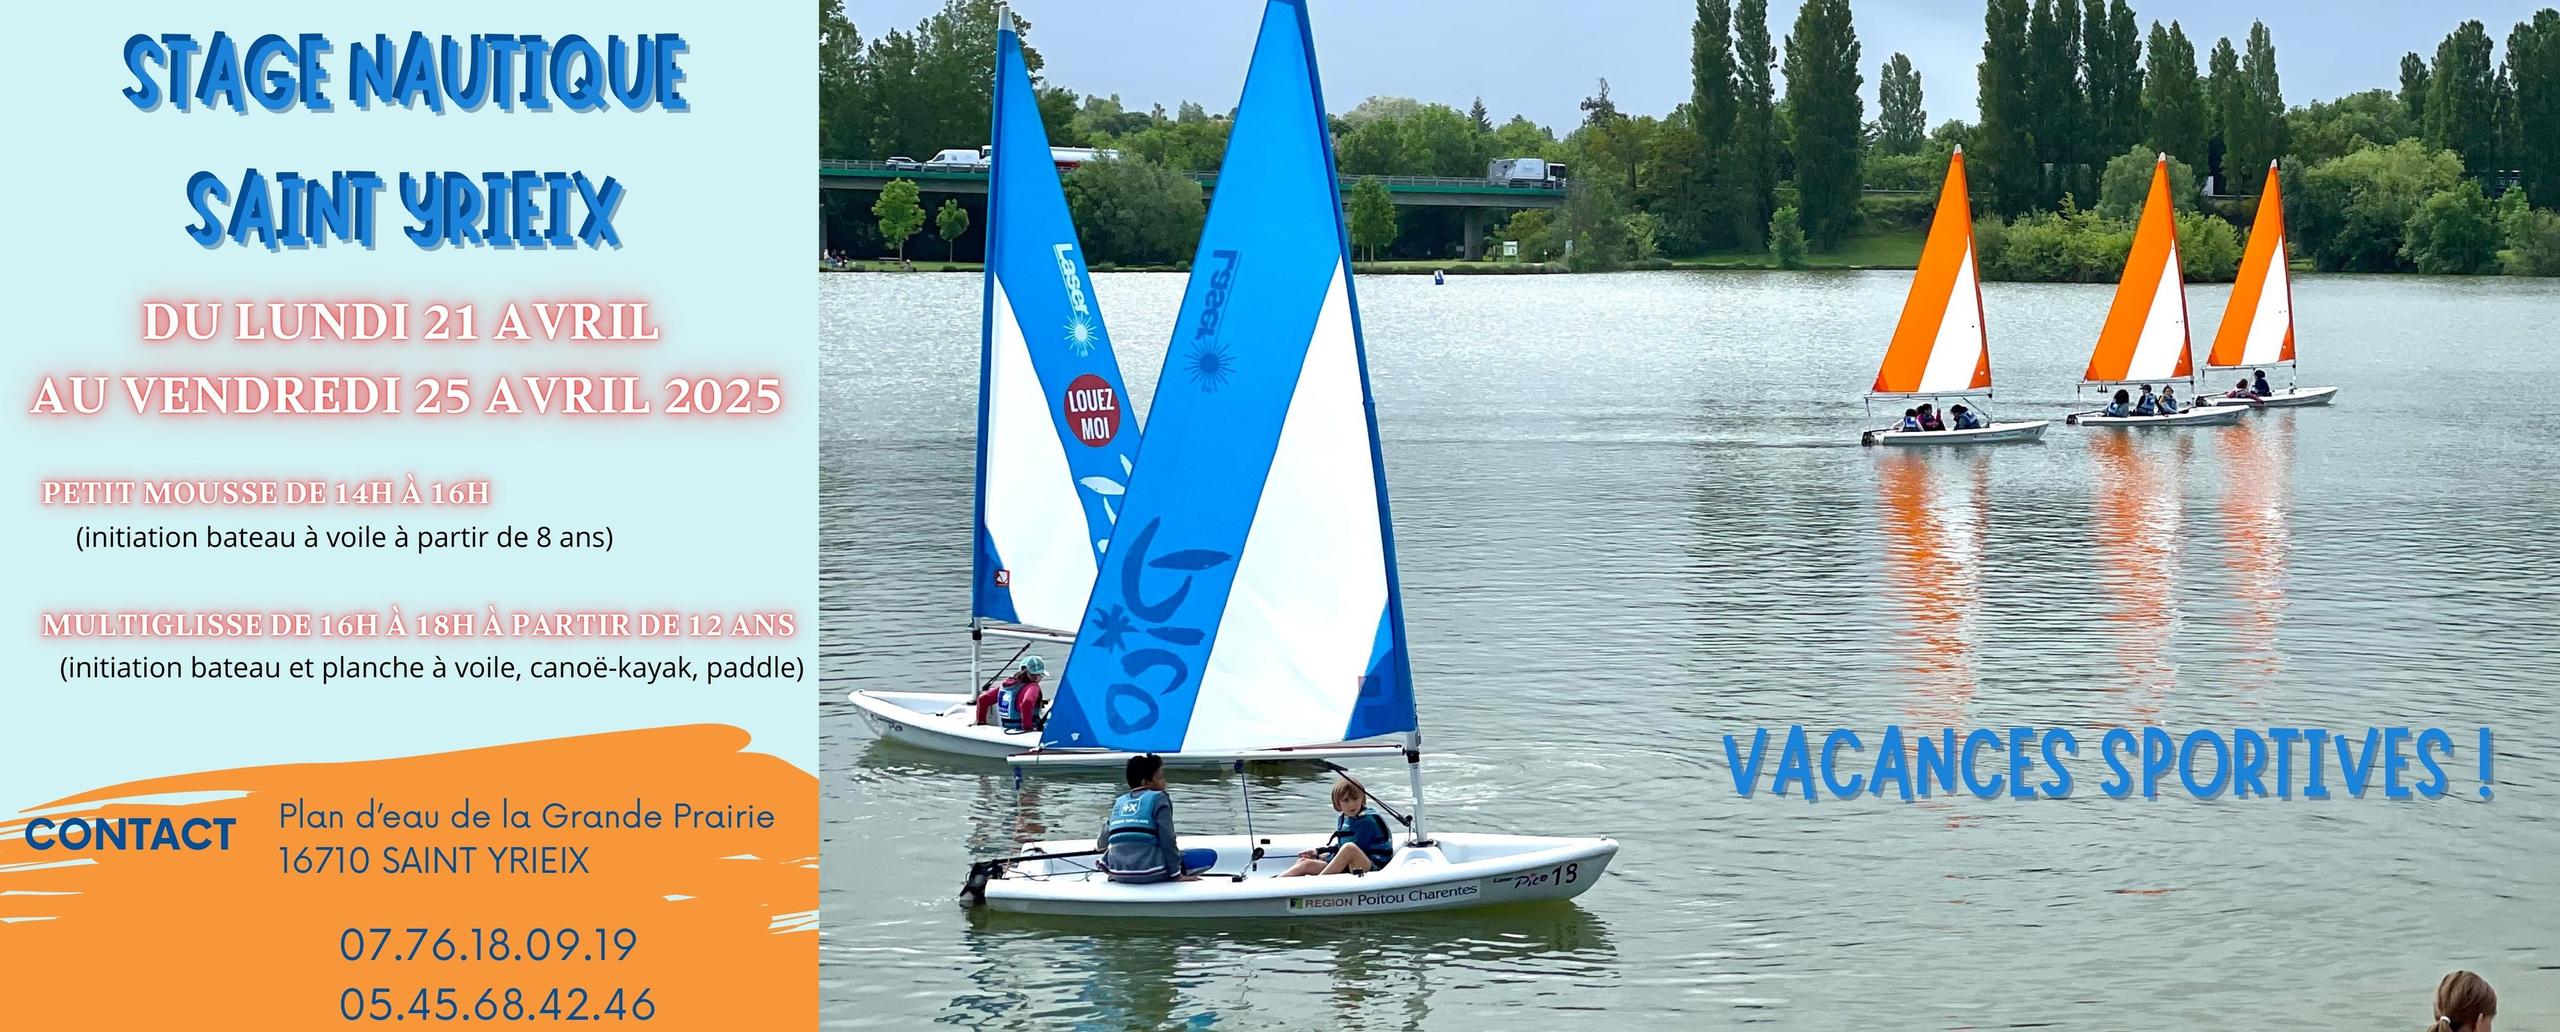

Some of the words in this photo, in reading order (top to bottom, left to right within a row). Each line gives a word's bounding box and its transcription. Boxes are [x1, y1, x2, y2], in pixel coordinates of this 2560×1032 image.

[1053, 243, 1090, 316] Laser
[1068, 388, 1114, 412] LOUEZ
[1081, 417, 1110, 440] MOI
[1305, 898, 1353, 908] REGION
[1357, 893, 1404, 906] Poitou
[1408, 884, 1478, 901] Charentes
